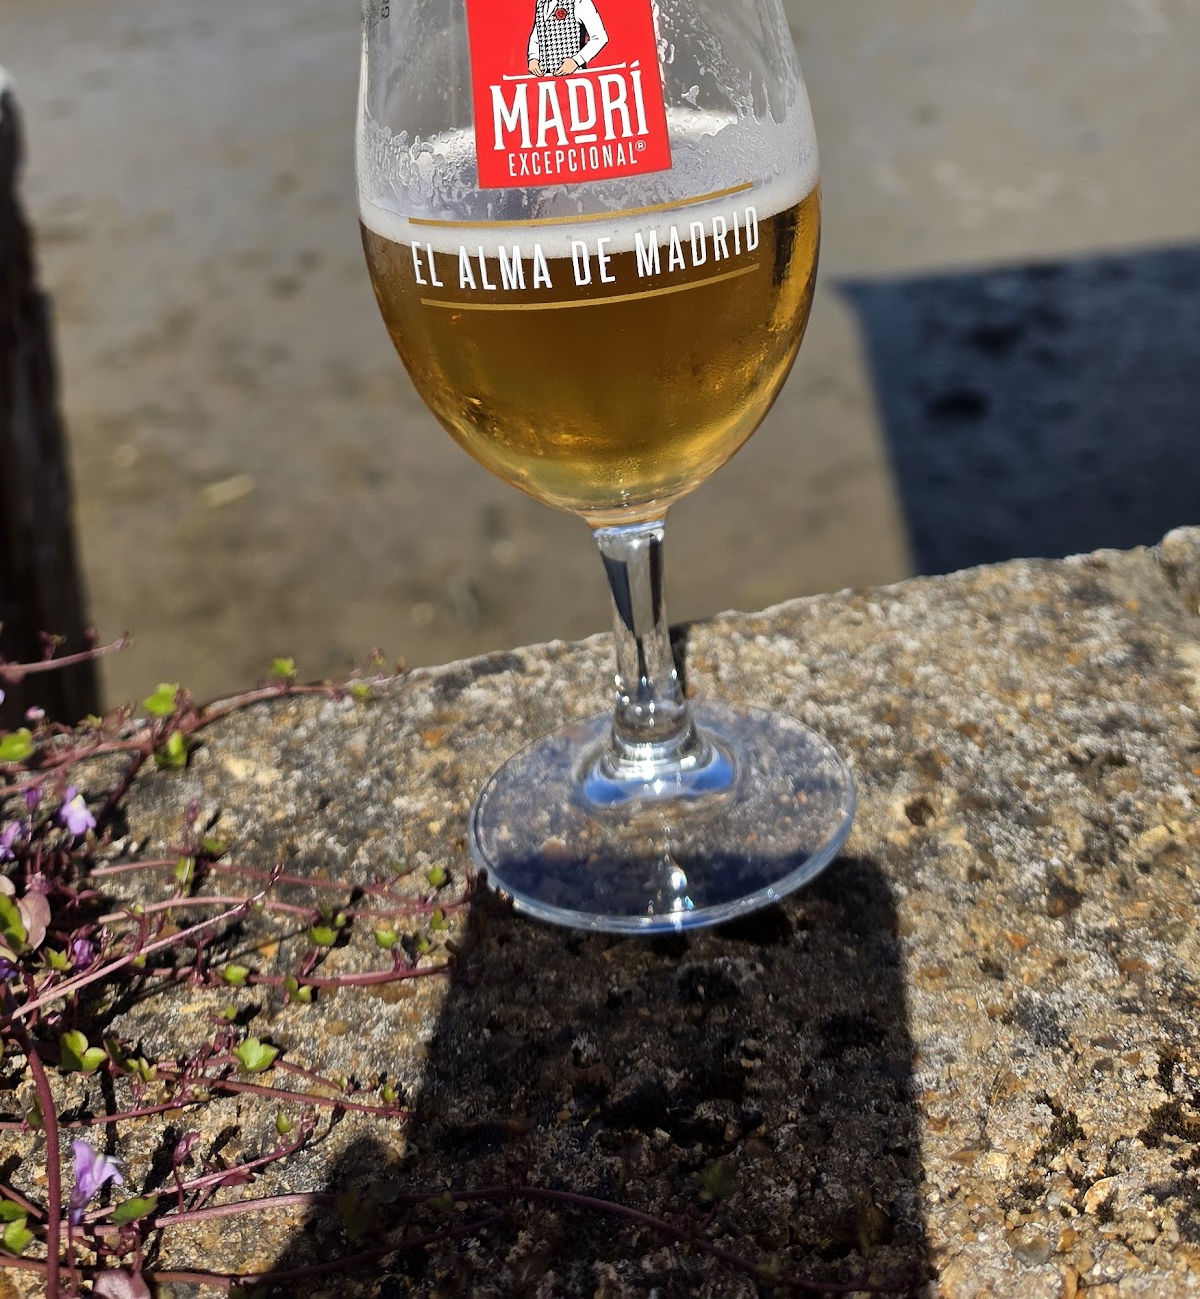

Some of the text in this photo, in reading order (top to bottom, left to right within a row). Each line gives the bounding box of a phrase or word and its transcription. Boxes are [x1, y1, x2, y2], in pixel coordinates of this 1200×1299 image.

[489, 59, 649, 150] MADRÍ
[410, 206, 760, 290] EL ALMA DE MADRID
